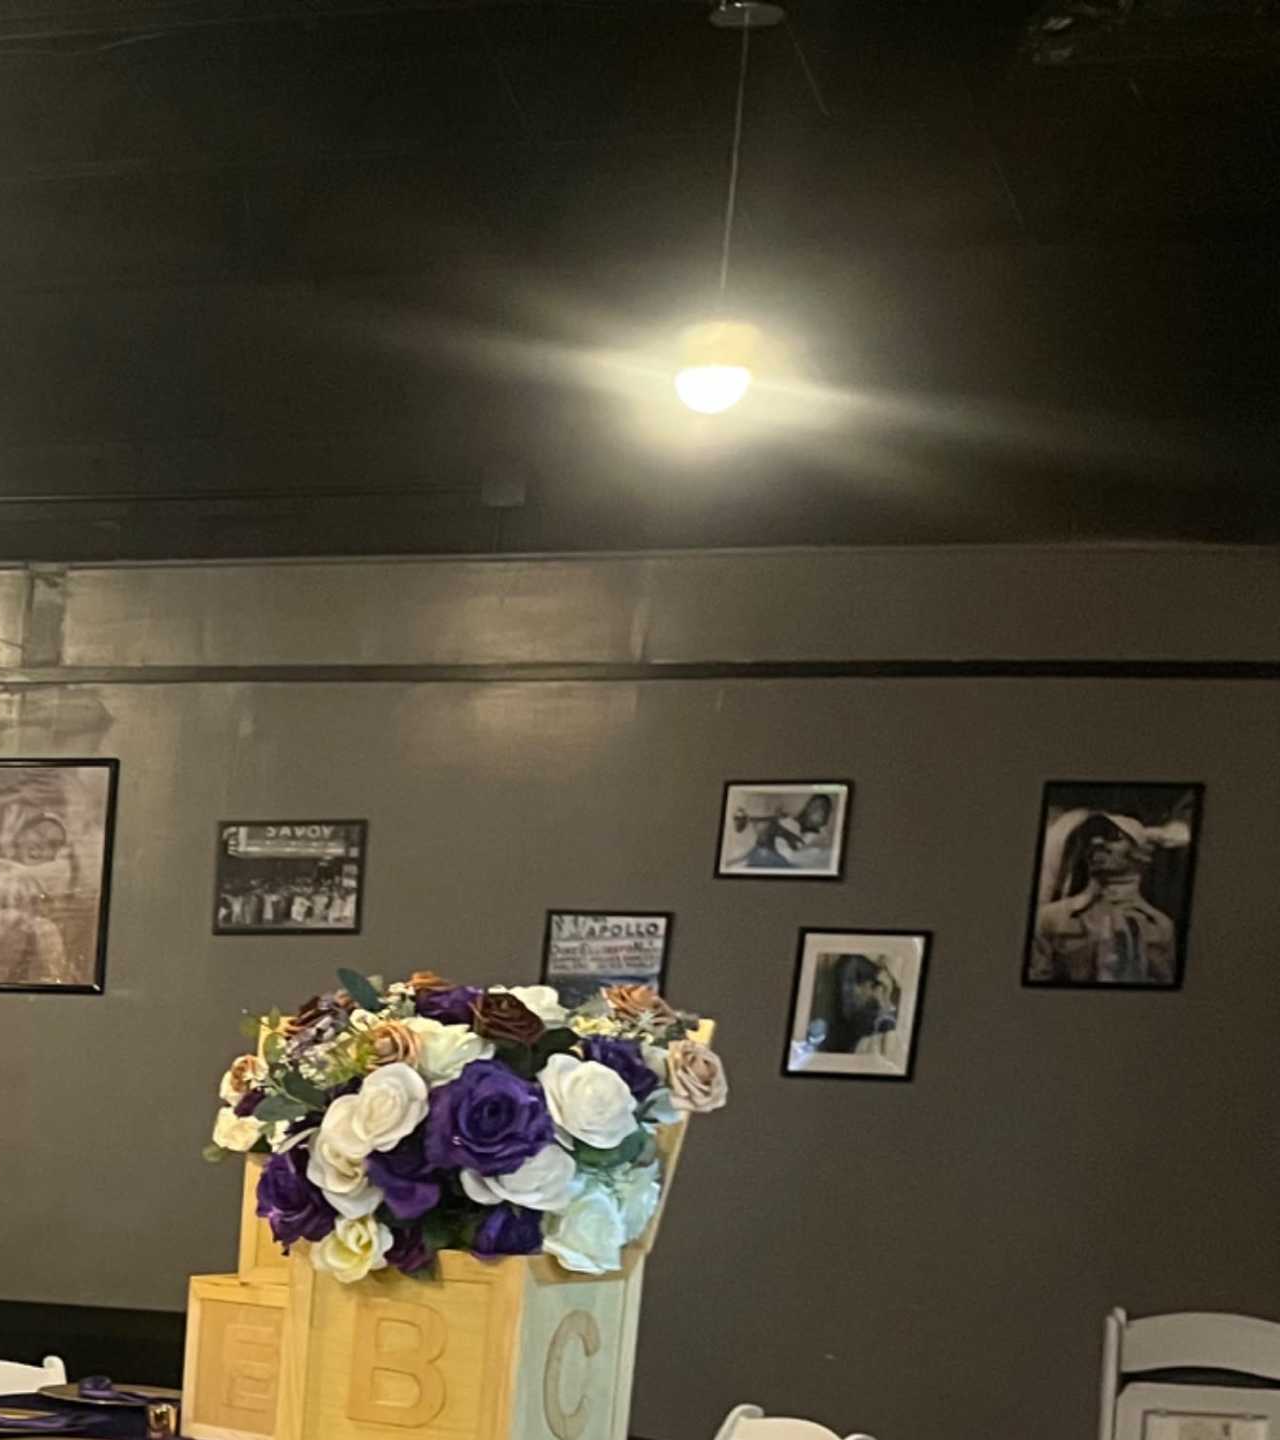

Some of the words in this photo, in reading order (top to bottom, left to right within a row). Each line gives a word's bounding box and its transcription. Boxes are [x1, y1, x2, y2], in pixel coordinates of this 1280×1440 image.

[265, 825, 335, 839] SAVOY
[585, 922, 659, 938] APOLLO
[347, 1300, 448, 1430] B
